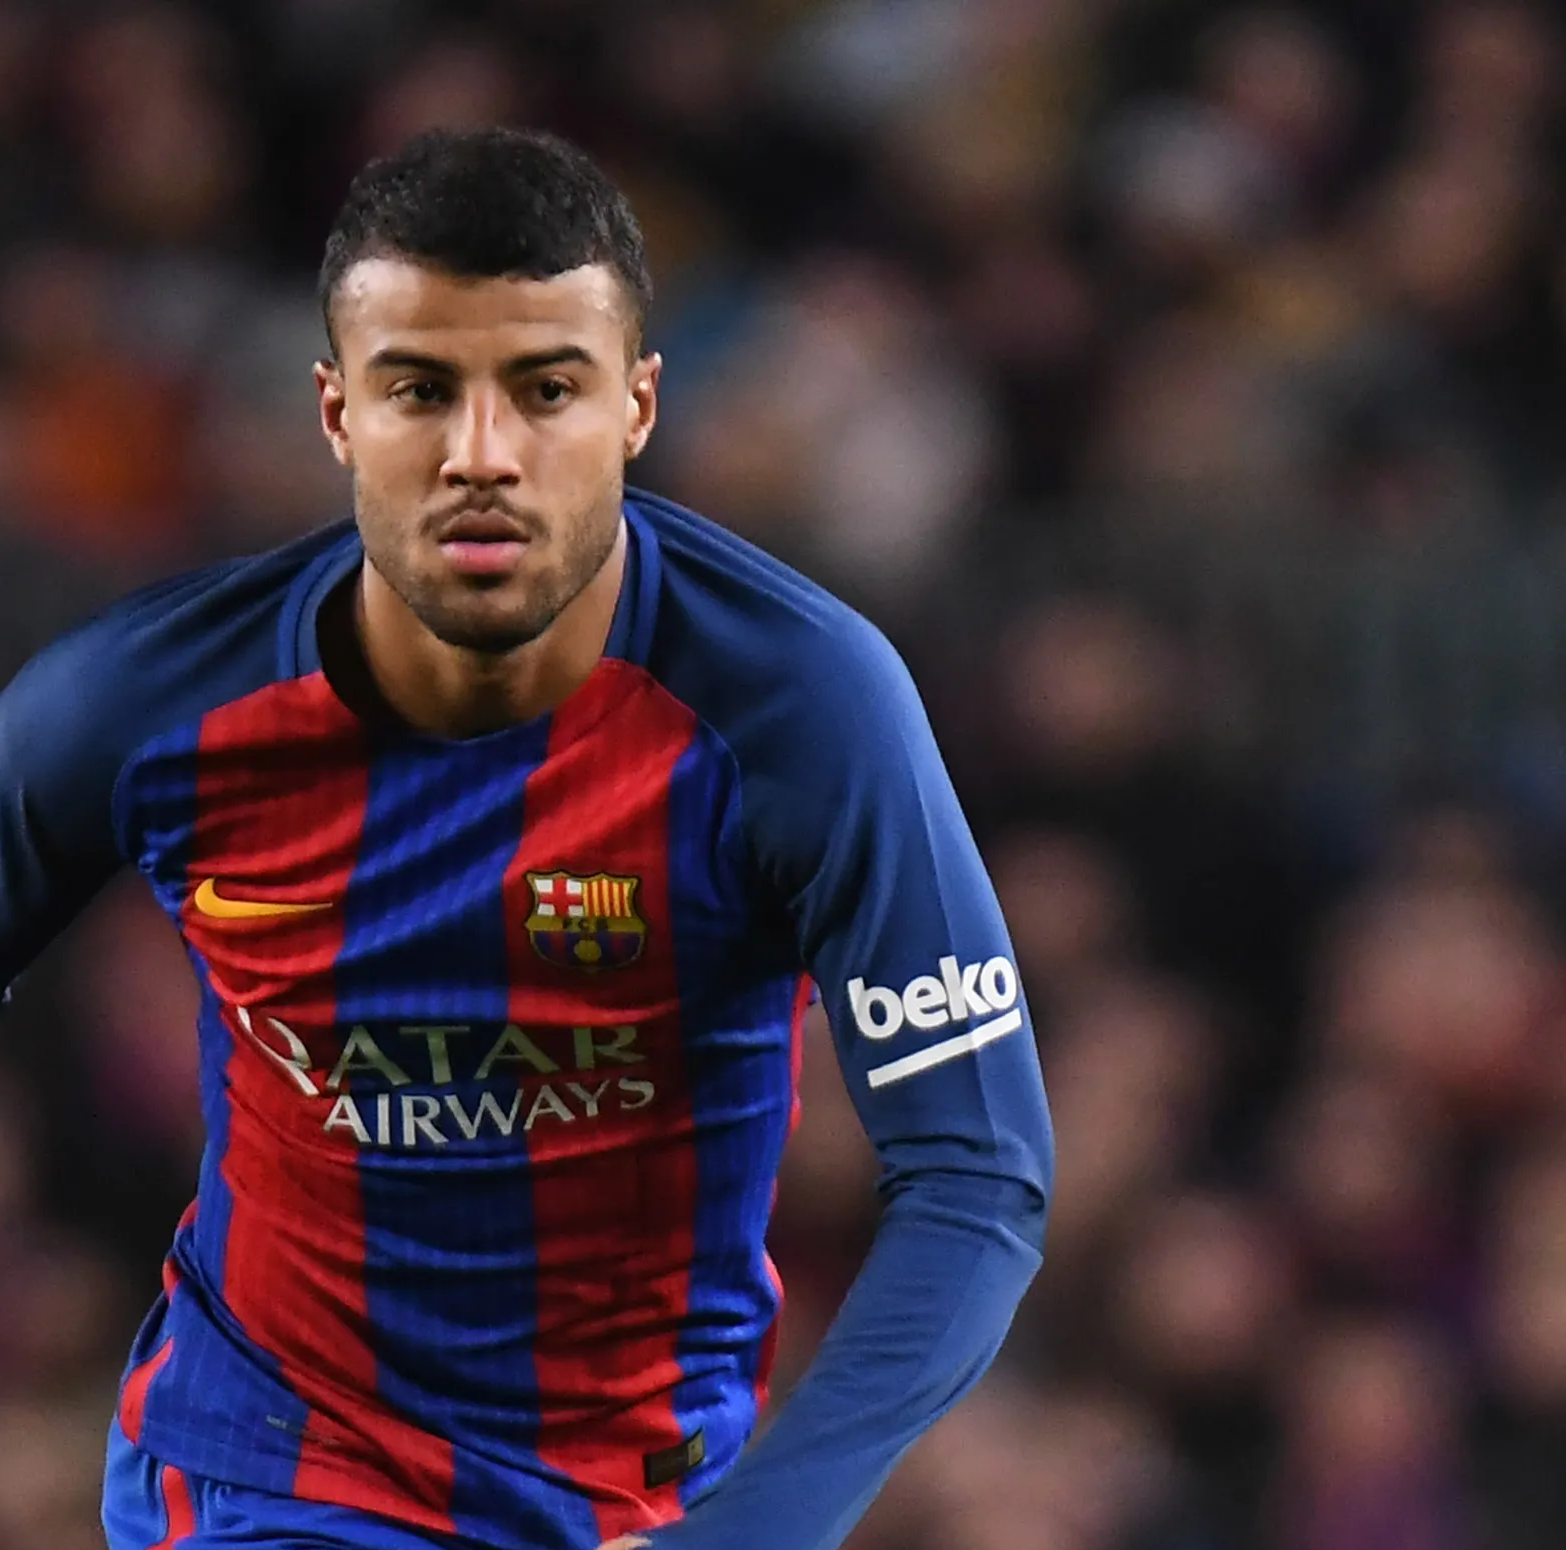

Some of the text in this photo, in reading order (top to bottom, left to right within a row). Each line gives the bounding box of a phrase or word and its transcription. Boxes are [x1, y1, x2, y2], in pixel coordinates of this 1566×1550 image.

[847, 954, 1018, 1039] beko
[236, 1004, 646, 1095] QATAR
[323, 1075, 656, 1147] AIRWAYS
